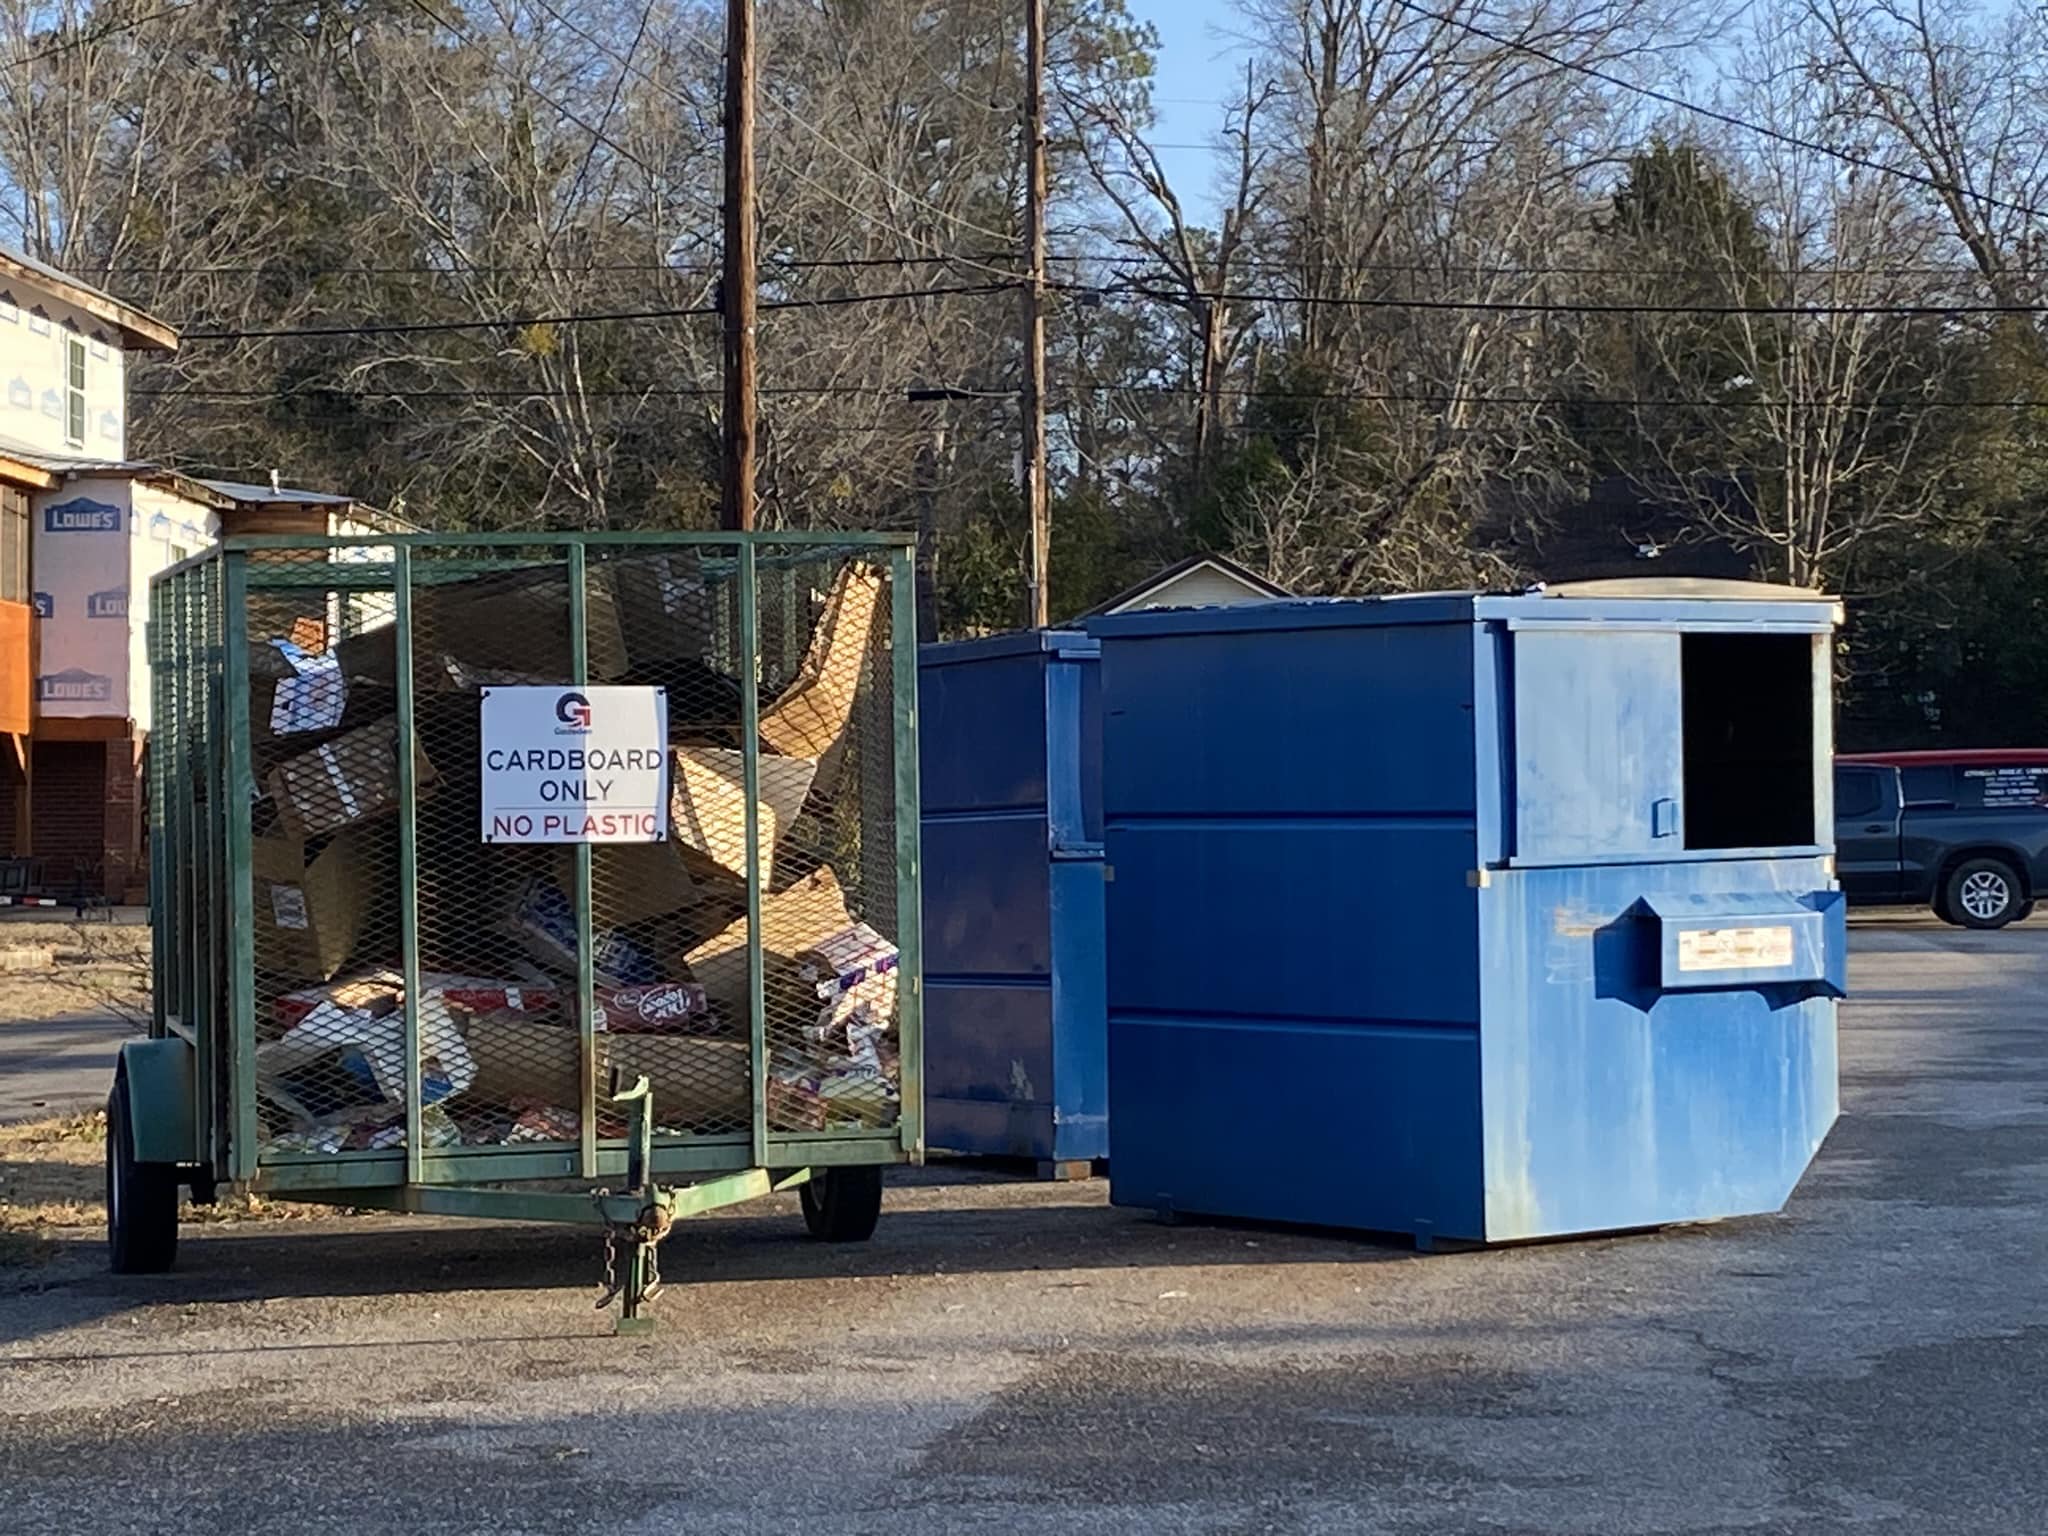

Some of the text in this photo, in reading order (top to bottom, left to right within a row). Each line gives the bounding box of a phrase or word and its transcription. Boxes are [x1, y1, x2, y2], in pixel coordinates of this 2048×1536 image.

[487, 750, 663, 771] CARDBOARD
[540, 779, 614, 802] ONLY
[494, 814, 657, 836] NO PLASTIC
